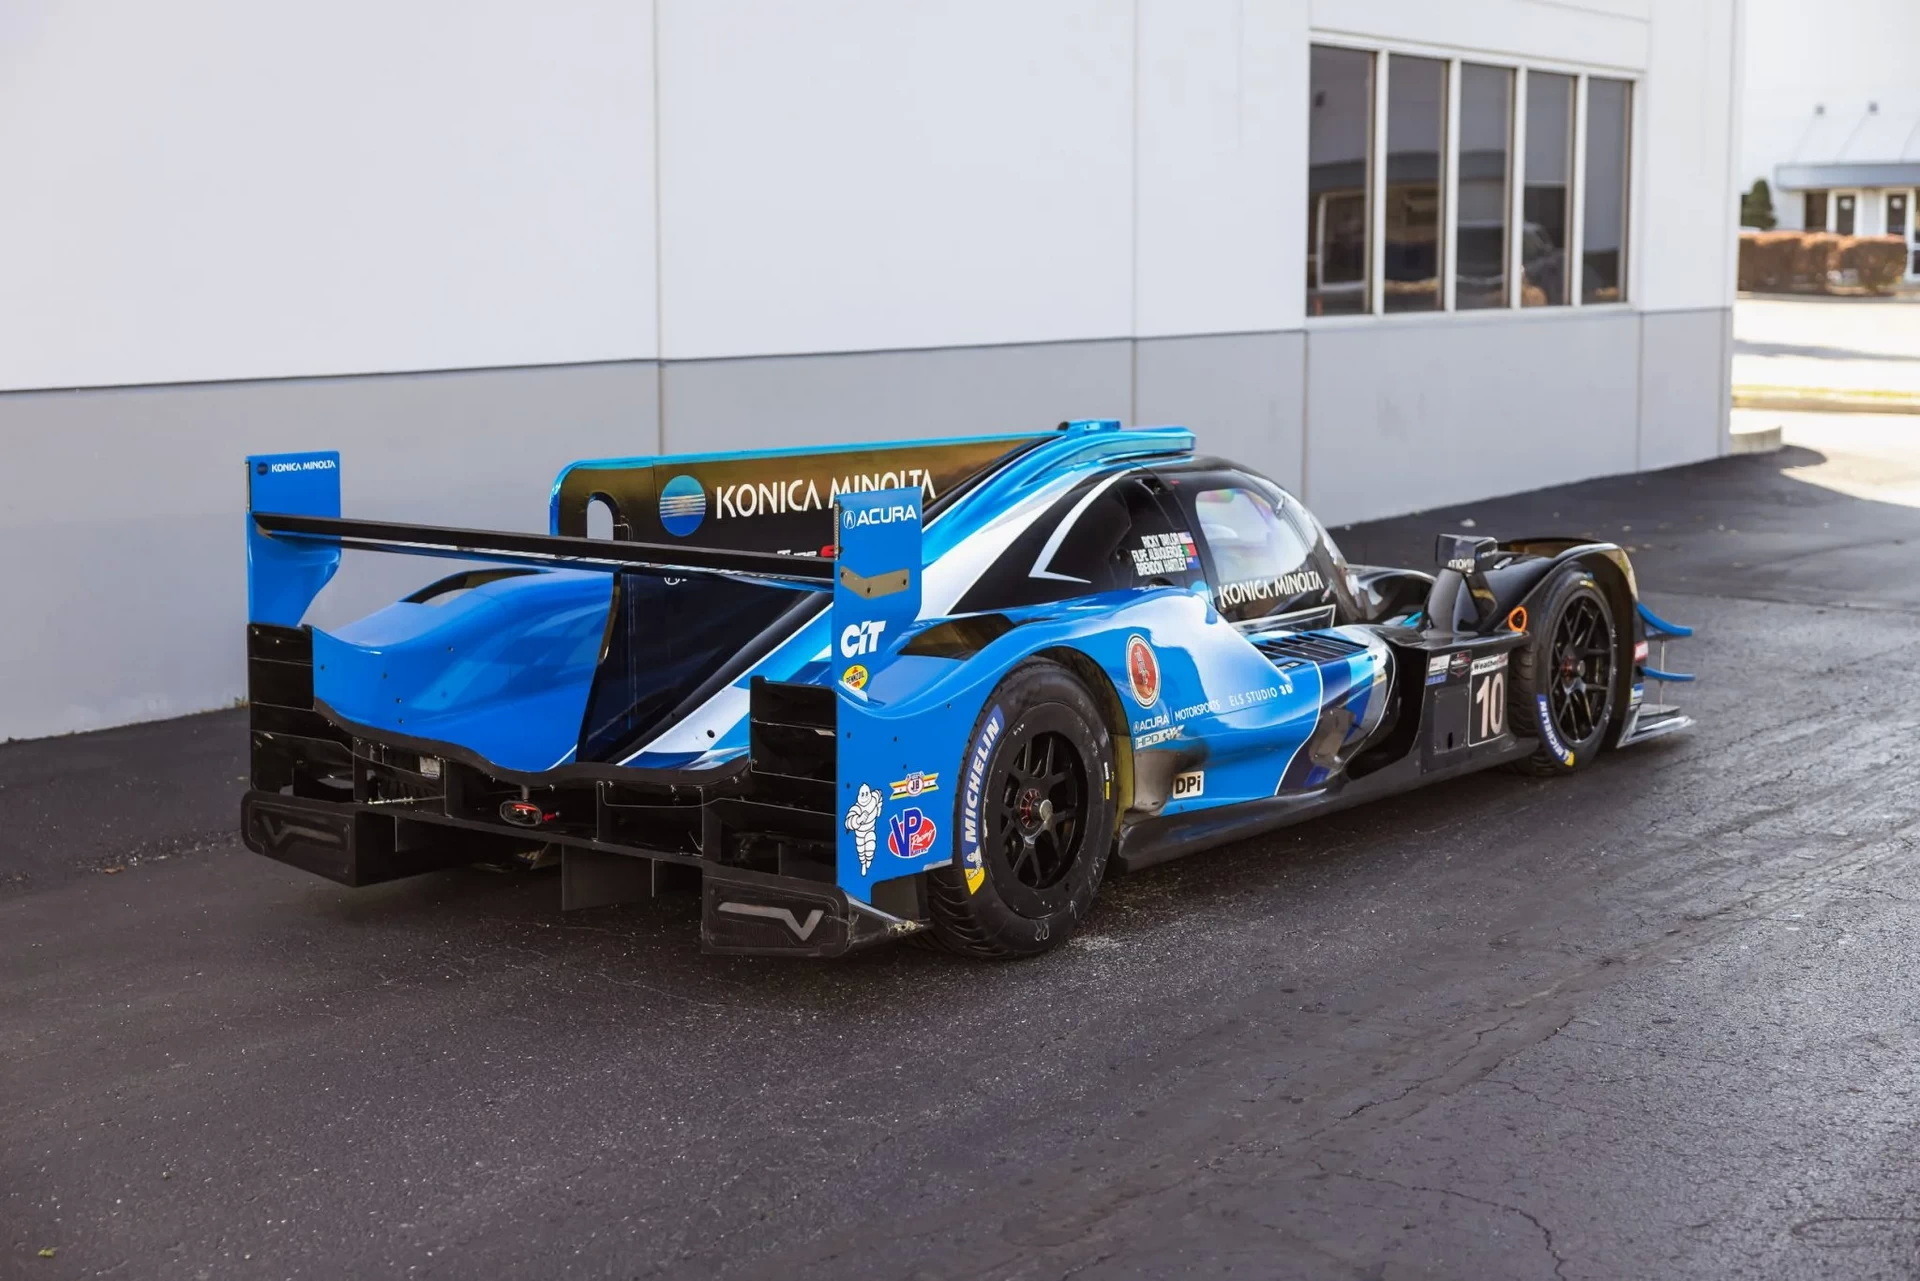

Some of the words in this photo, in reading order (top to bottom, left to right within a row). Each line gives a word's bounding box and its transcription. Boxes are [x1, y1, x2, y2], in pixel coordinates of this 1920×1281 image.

[271, 462, 302, 473] KONICA
[302, 459, 336, 470] MINOLTA
[716, 479, 822, 519] KONICA
[856, 504, 918, 527] ACURA
[1218, 579, 1273, 608] KONICA
[1273, 570, 1325, 597] MINOLTA
[1229, 691, 1244, 707] ELS
[1246, 687, 1278, 703] STUDIO
[1279, 684, 1293, 696] 3D
[1476, 672, 1504, 738] 10
[1139, 713, 1170, 731] ACURA
[1174, 699, 1221, 721] MOTORSPORTS
[1540, 701, 1565, 757] MICHELIN
[1136, 733, 1160, 748] HPD
[910, 779, 920, 791] JB
[964, 717, 1000, 843] MICHELIN
[1175, 775, 1202, 795] DPi
[890, 807, 923, 857] VP
